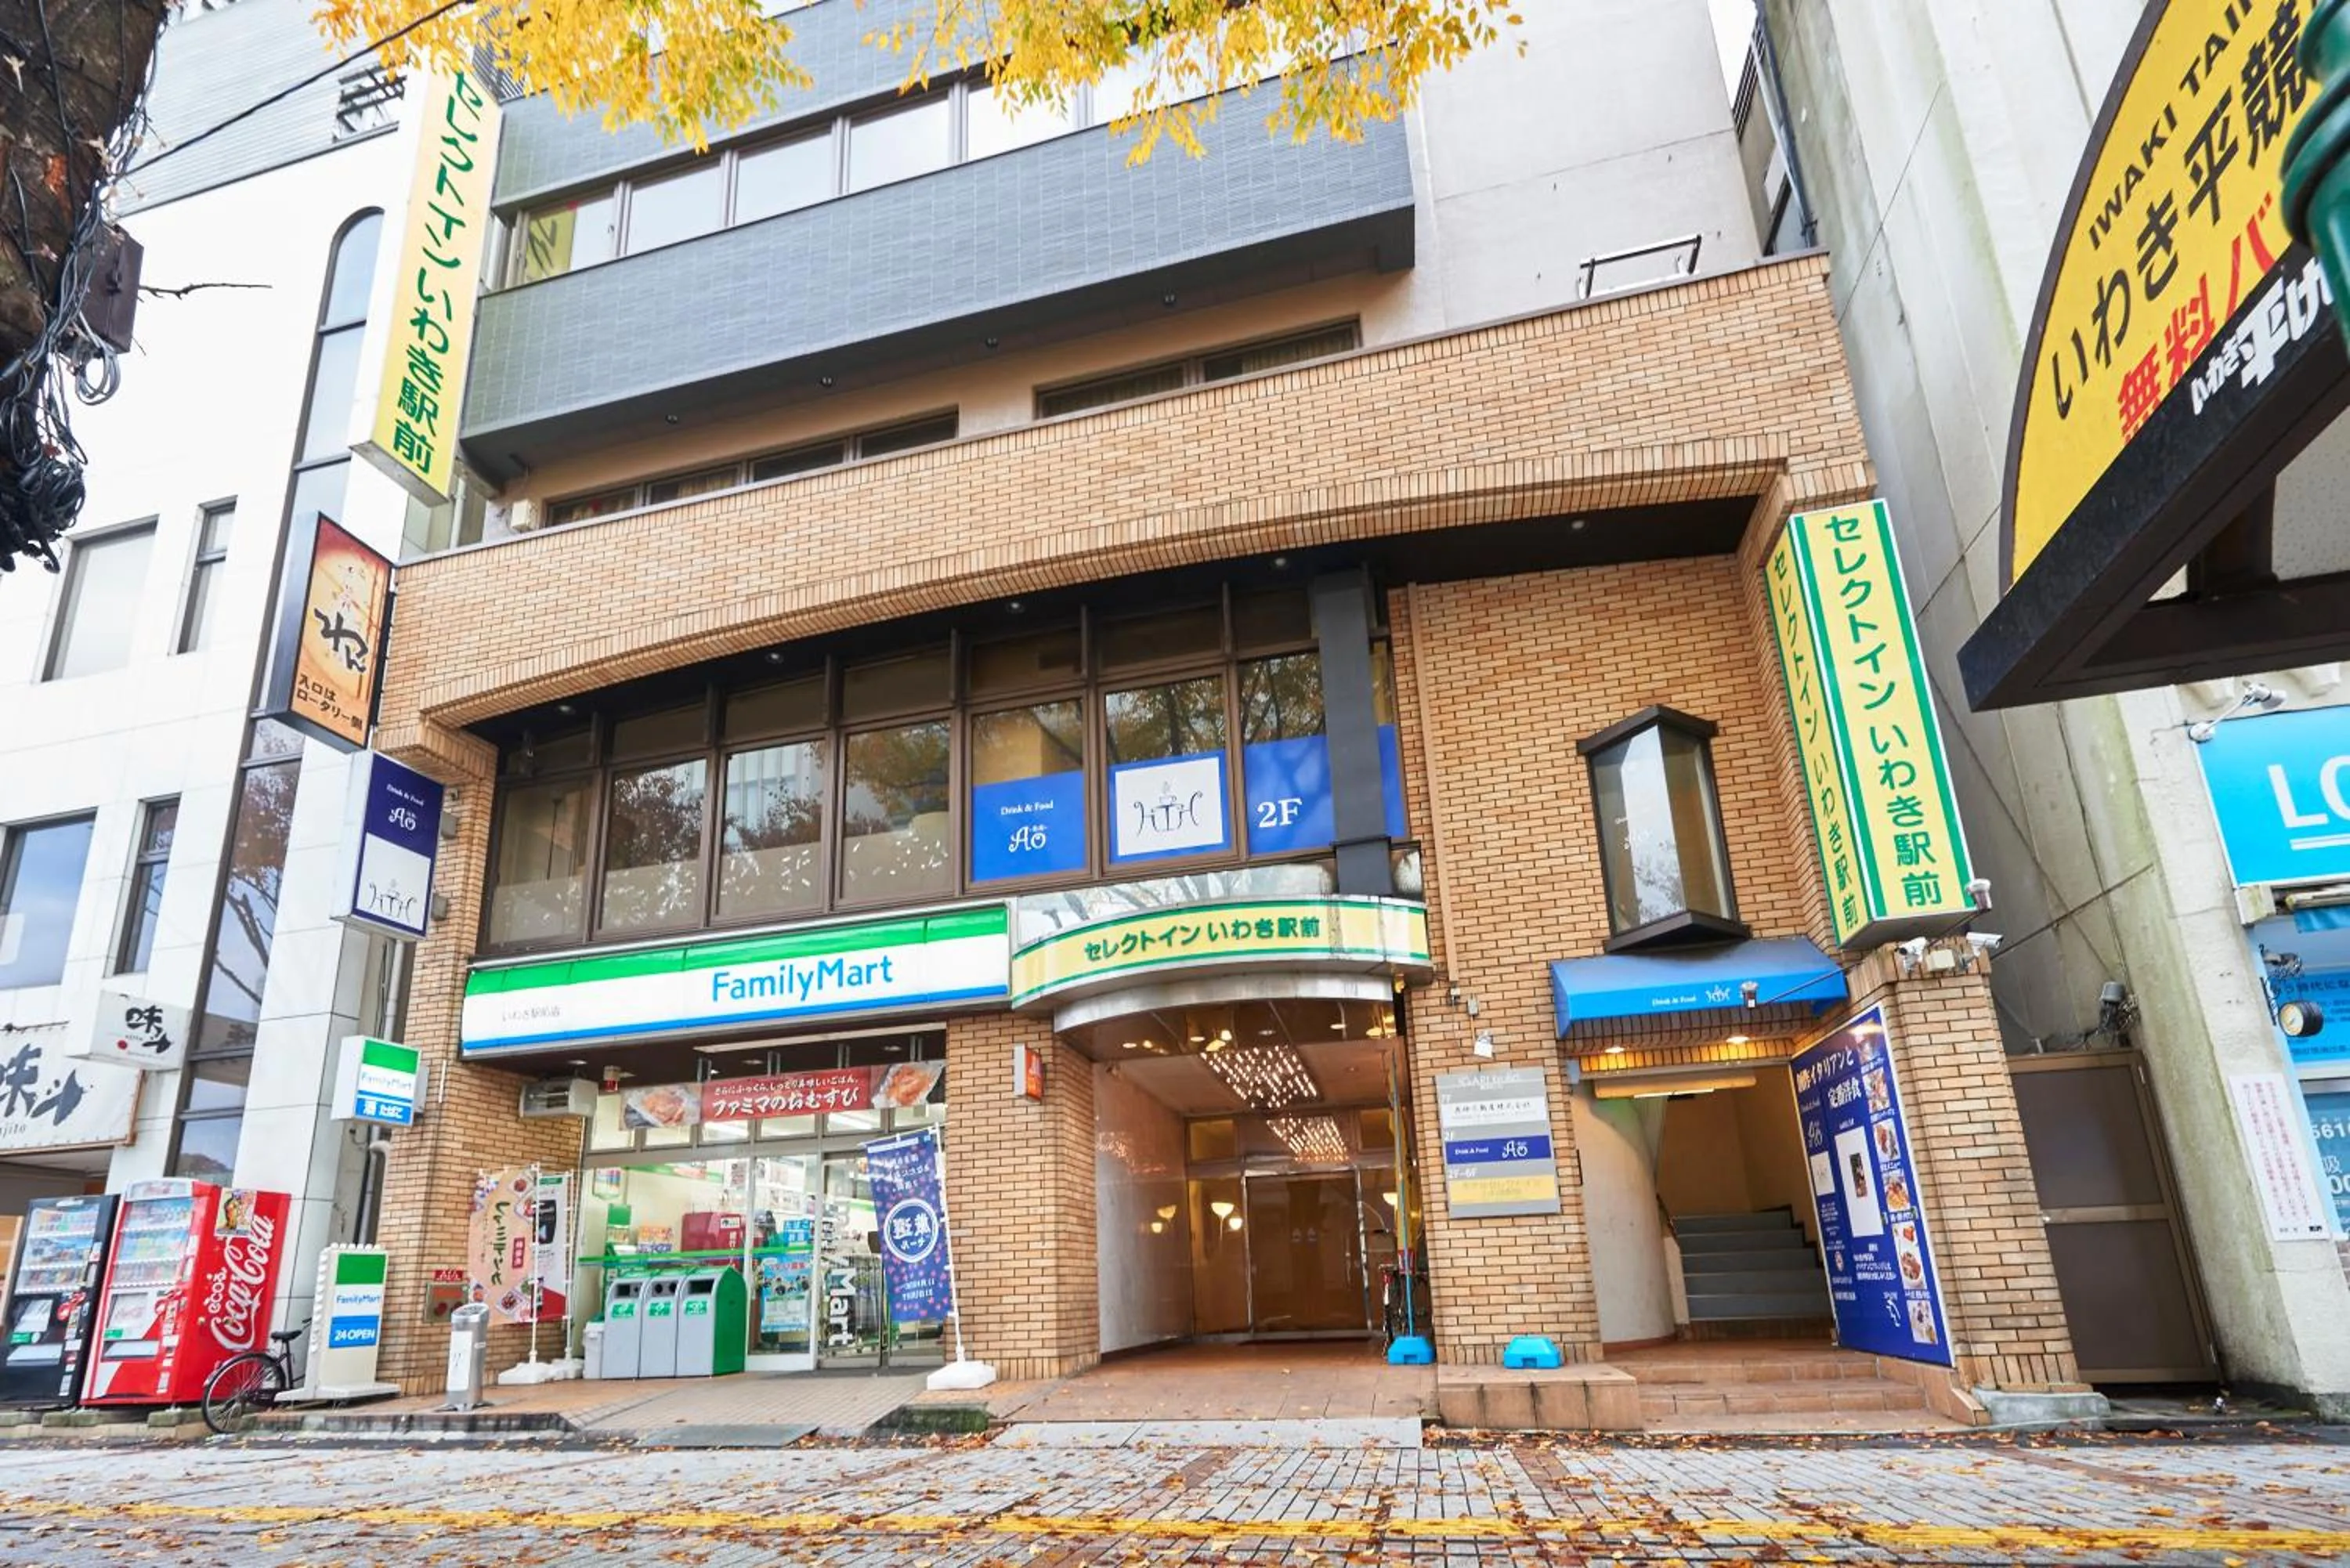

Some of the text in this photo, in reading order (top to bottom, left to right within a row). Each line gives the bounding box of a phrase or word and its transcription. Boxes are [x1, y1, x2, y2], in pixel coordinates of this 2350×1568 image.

[2088, 0, 2252, 251] IWAKI TAI
[298, 674, 337, 703] 入口は
[1000, 799, 1054, 815] Drink & Food
[1257, 797, 1303, 828] 2F
[712, 955, 893, 1003] FamilyMart
[361, 1071, 412, 1091] FamilyMart
[712, 1087, 859, 1118] ファミマのおむすび
[335, 1294, 381, 1304] FamilyMart
[347, 1328, 376, 1340] OPEN
